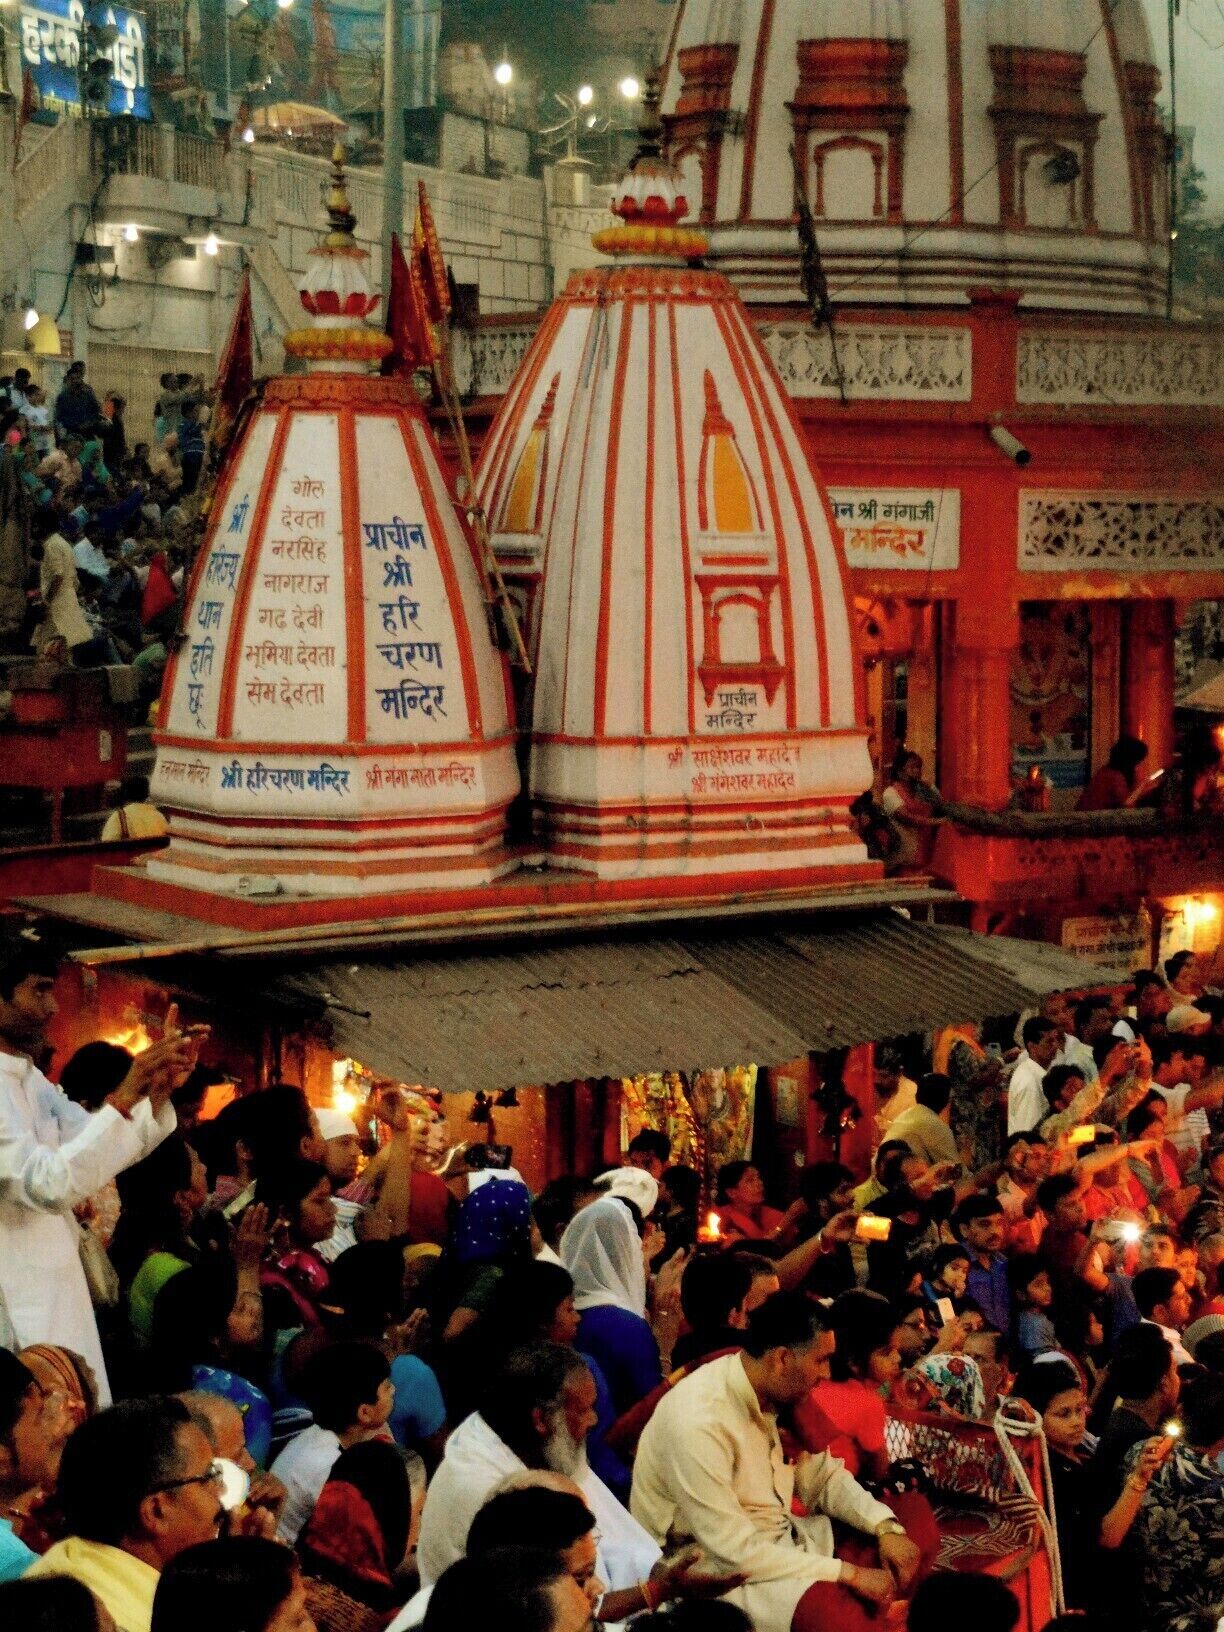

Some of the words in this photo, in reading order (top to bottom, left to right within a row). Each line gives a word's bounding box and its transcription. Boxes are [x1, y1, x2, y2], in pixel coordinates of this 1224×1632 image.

[291, 476, 325, 499] गोल
[228, 493, 249, 533] श्री
[281, 505, 326, 530] देवता
[858, 498, 878, 520] श्री
[362, 516, 427, 550] प्राचीन
[272, 536, 328, 564] नरसिंह
[263, 573, 331, 595] नागराज
[383, 554, 413, 587] श्री
[292, 604, 324, 634] देवी
[378, 595, 422, 636] हरि
[246, 640, 293, 670] भूमिया
[296, 640, 335, 671] देवता
[376, 642, 443, 671] चरण
[246, 677, 277, 706] सेम
[280, 677, 324, 710] देवता
[375, 679, 447, 722] मन्दिर
[717, 687, 757, 706] प्राचीन
[705, 708, 757, 730] मन्दिर
[221, 760, 243, 788] श्री
[307, 763, 350, 797] मन्दिर
[366, 763, 383, 790] श्री
